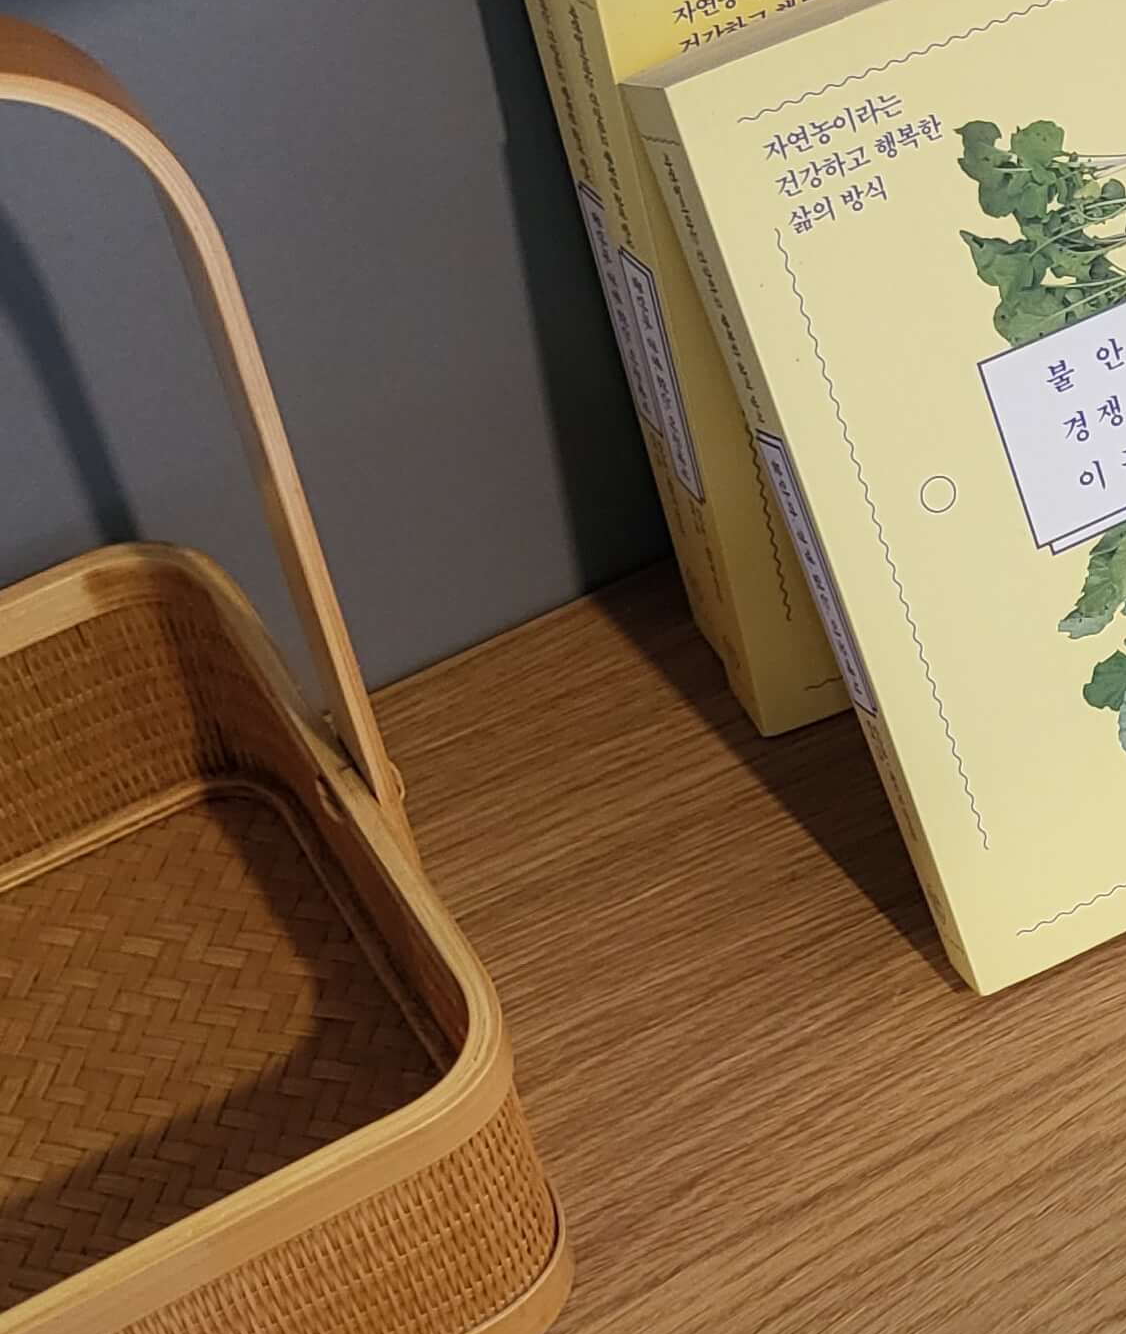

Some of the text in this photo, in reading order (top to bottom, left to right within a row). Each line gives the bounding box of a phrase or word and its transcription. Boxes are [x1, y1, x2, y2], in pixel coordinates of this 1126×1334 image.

[762, 93, 904, 162] 자연농이라는
[774, 114, 945, 197] 건강하고 행복한
[787, 175, 889, 234] 삶의 방식
